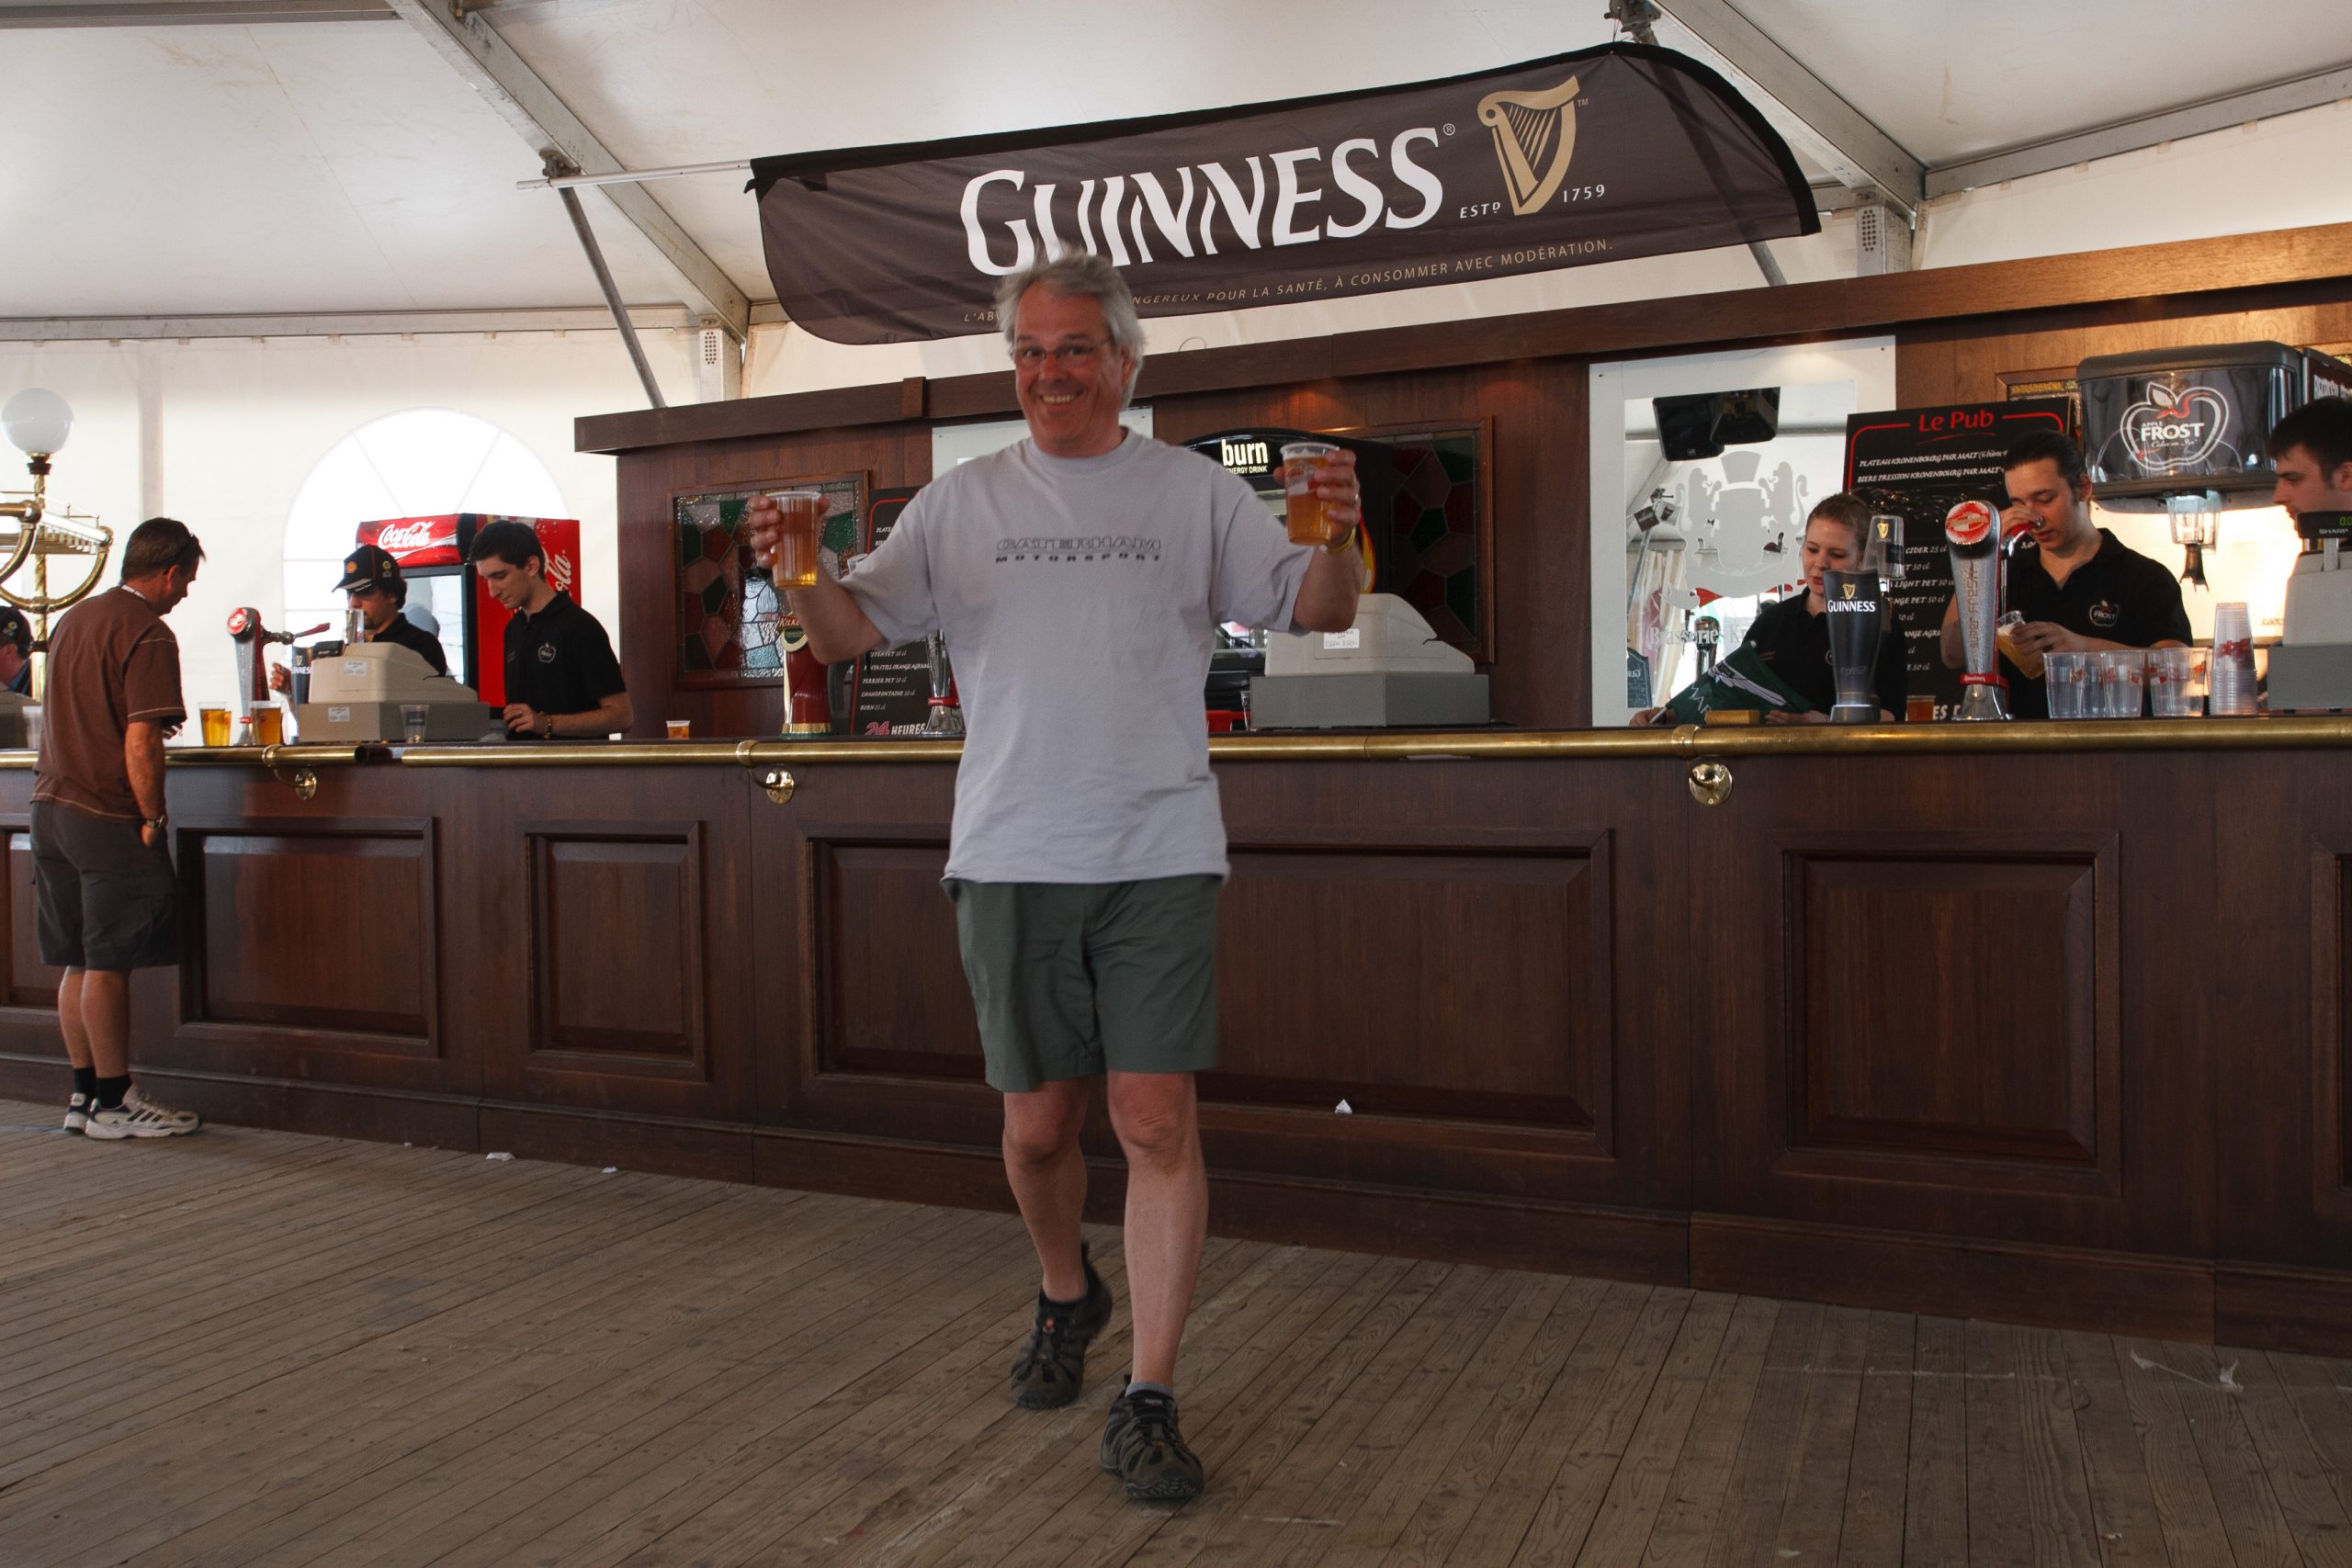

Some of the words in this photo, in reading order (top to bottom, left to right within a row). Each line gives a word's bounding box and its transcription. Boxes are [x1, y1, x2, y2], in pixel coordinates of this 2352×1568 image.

[960, 127, 1443, 276] GUINNESS
[1563, 184, 1605, 203] 1759
[1132, 292, 1200, 305] NGEREUX
[1206, 289, 1246, 301] POUR
[1253, 286, 1270, 298] LA
[1276, 277, 1329, 295] SANTÉ,
[1335, 275, 1344, 288] À
[1351, 263, 1449, 287] CONSOMMER
[1455, 255, 1494, 272] AVEC
[1500, 239, 1613, 265] MODÉRATION.
[1918, 413, 1945, 433] Le
[1950, 409, 1995, 430] Pub
[2141, 423, 2205, 442] FROST
[1221, 438, 1269, 467] burn
[1891, 455, 1941, 465] KRONENBOURG
[1941, 453, 1958, 461] PUR
[1958, 452, 1979, 460] MALT
[1857, 474, 1878, 483] BIERE
[1878, 472, 1910, 482] PRESSION
[1910, 469, 1962, 479] KRONENBOURG
[1962, 468, 1978, 476] PUR
[1905, 546, 1929, 554] CIDER
[1894, 580, 1919, 589] LIGHT
[1920, 580, 1938, 588] PET
[1827, 600, 1876, 614] GUINNESS
[865, 720, 889, 735] 24
